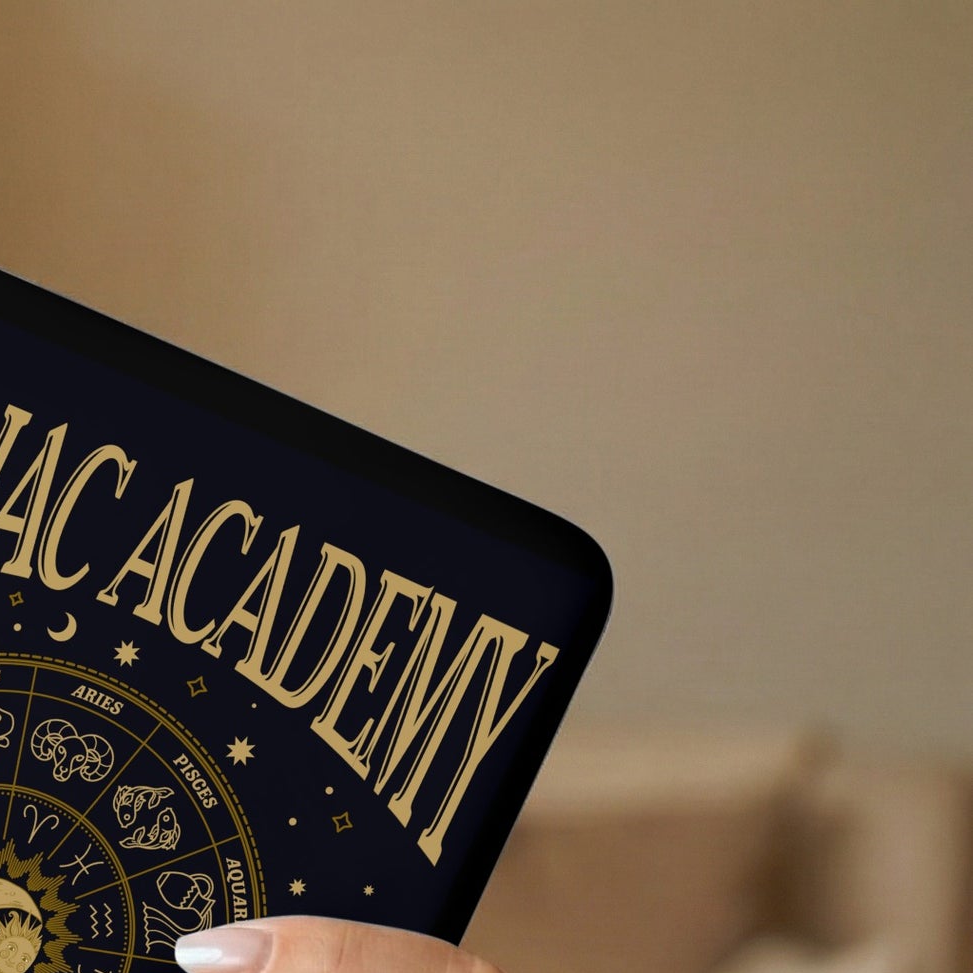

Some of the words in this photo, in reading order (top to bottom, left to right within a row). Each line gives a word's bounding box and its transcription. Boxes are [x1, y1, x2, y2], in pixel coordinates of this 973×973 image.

[71, 685, 124, 715] ARIES
[96, 478, 561, 867] ACADEMY
[173, 754, 218, 809] PISCES
[226, 858, 248, 922] AQUAR
